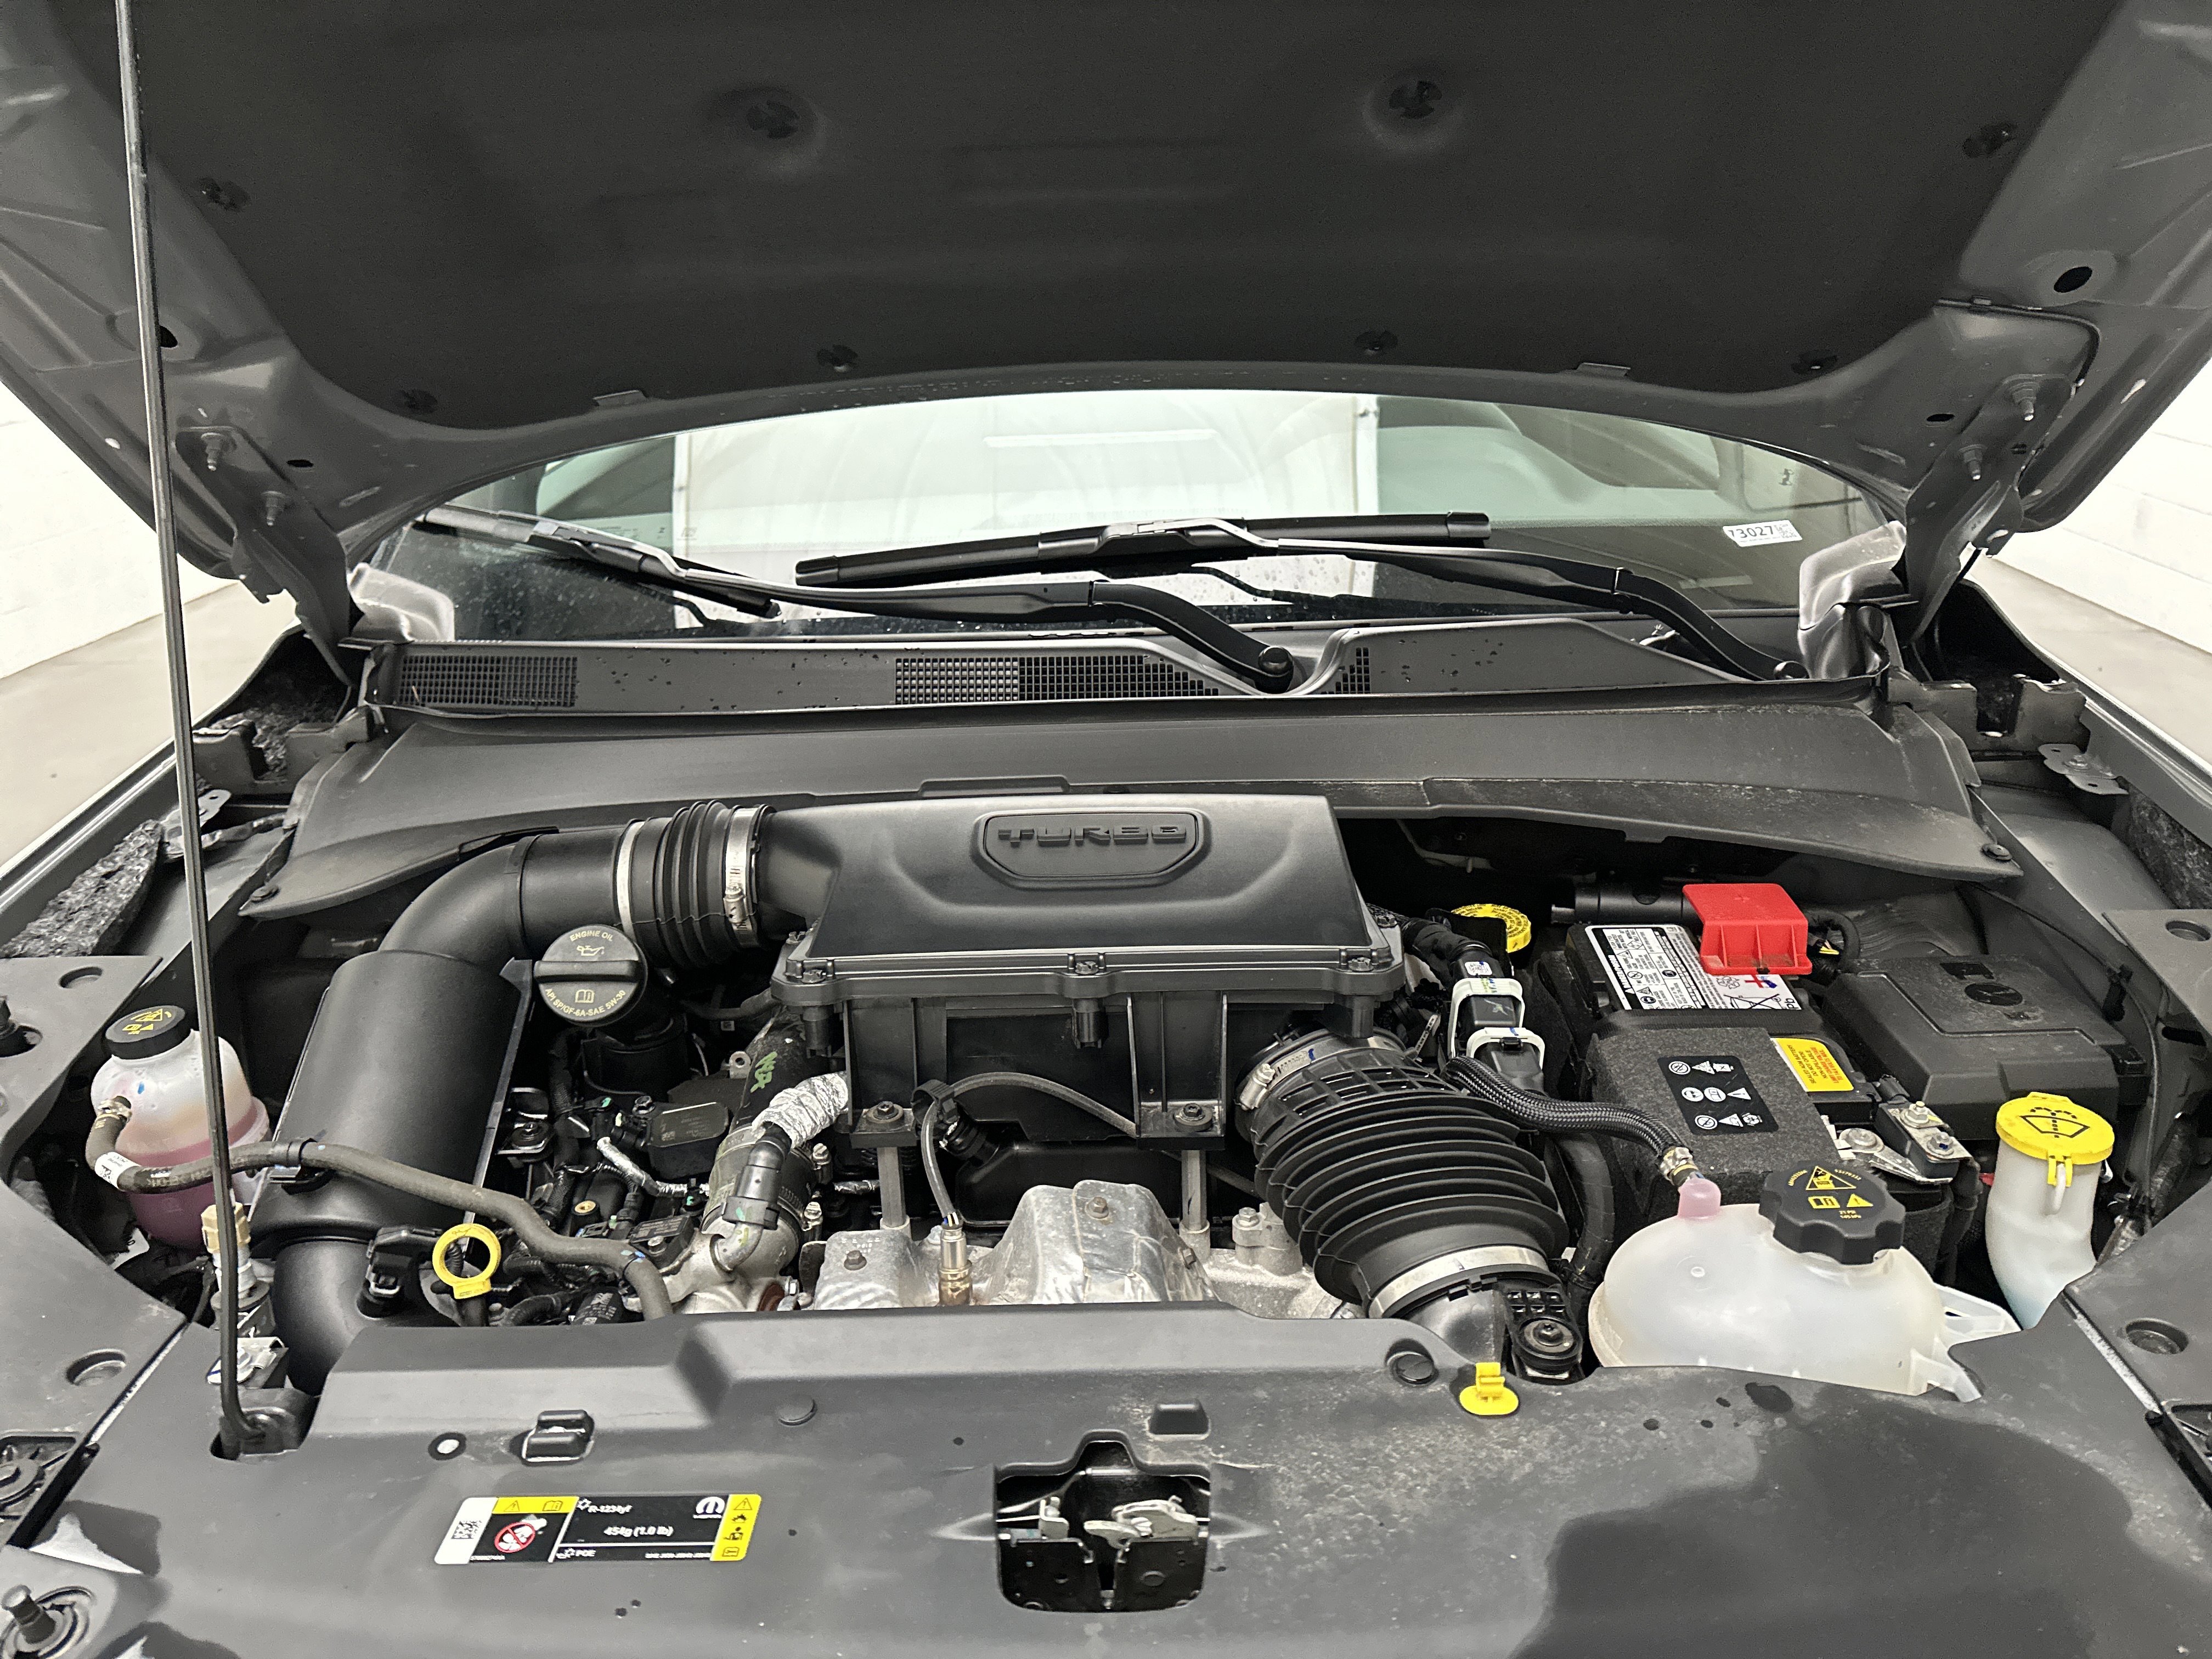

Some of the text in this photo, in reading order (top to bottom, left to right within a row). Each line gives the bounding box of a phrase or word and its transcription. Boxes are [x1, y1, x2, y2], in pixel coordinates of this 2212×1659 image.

[997, 825, 1187, 847] TURBO
[569, 930, 613, 942] ENGINE OIL
[545, 988, 557, 1001] API
[606, 990, 627, 1009] 5W-30
